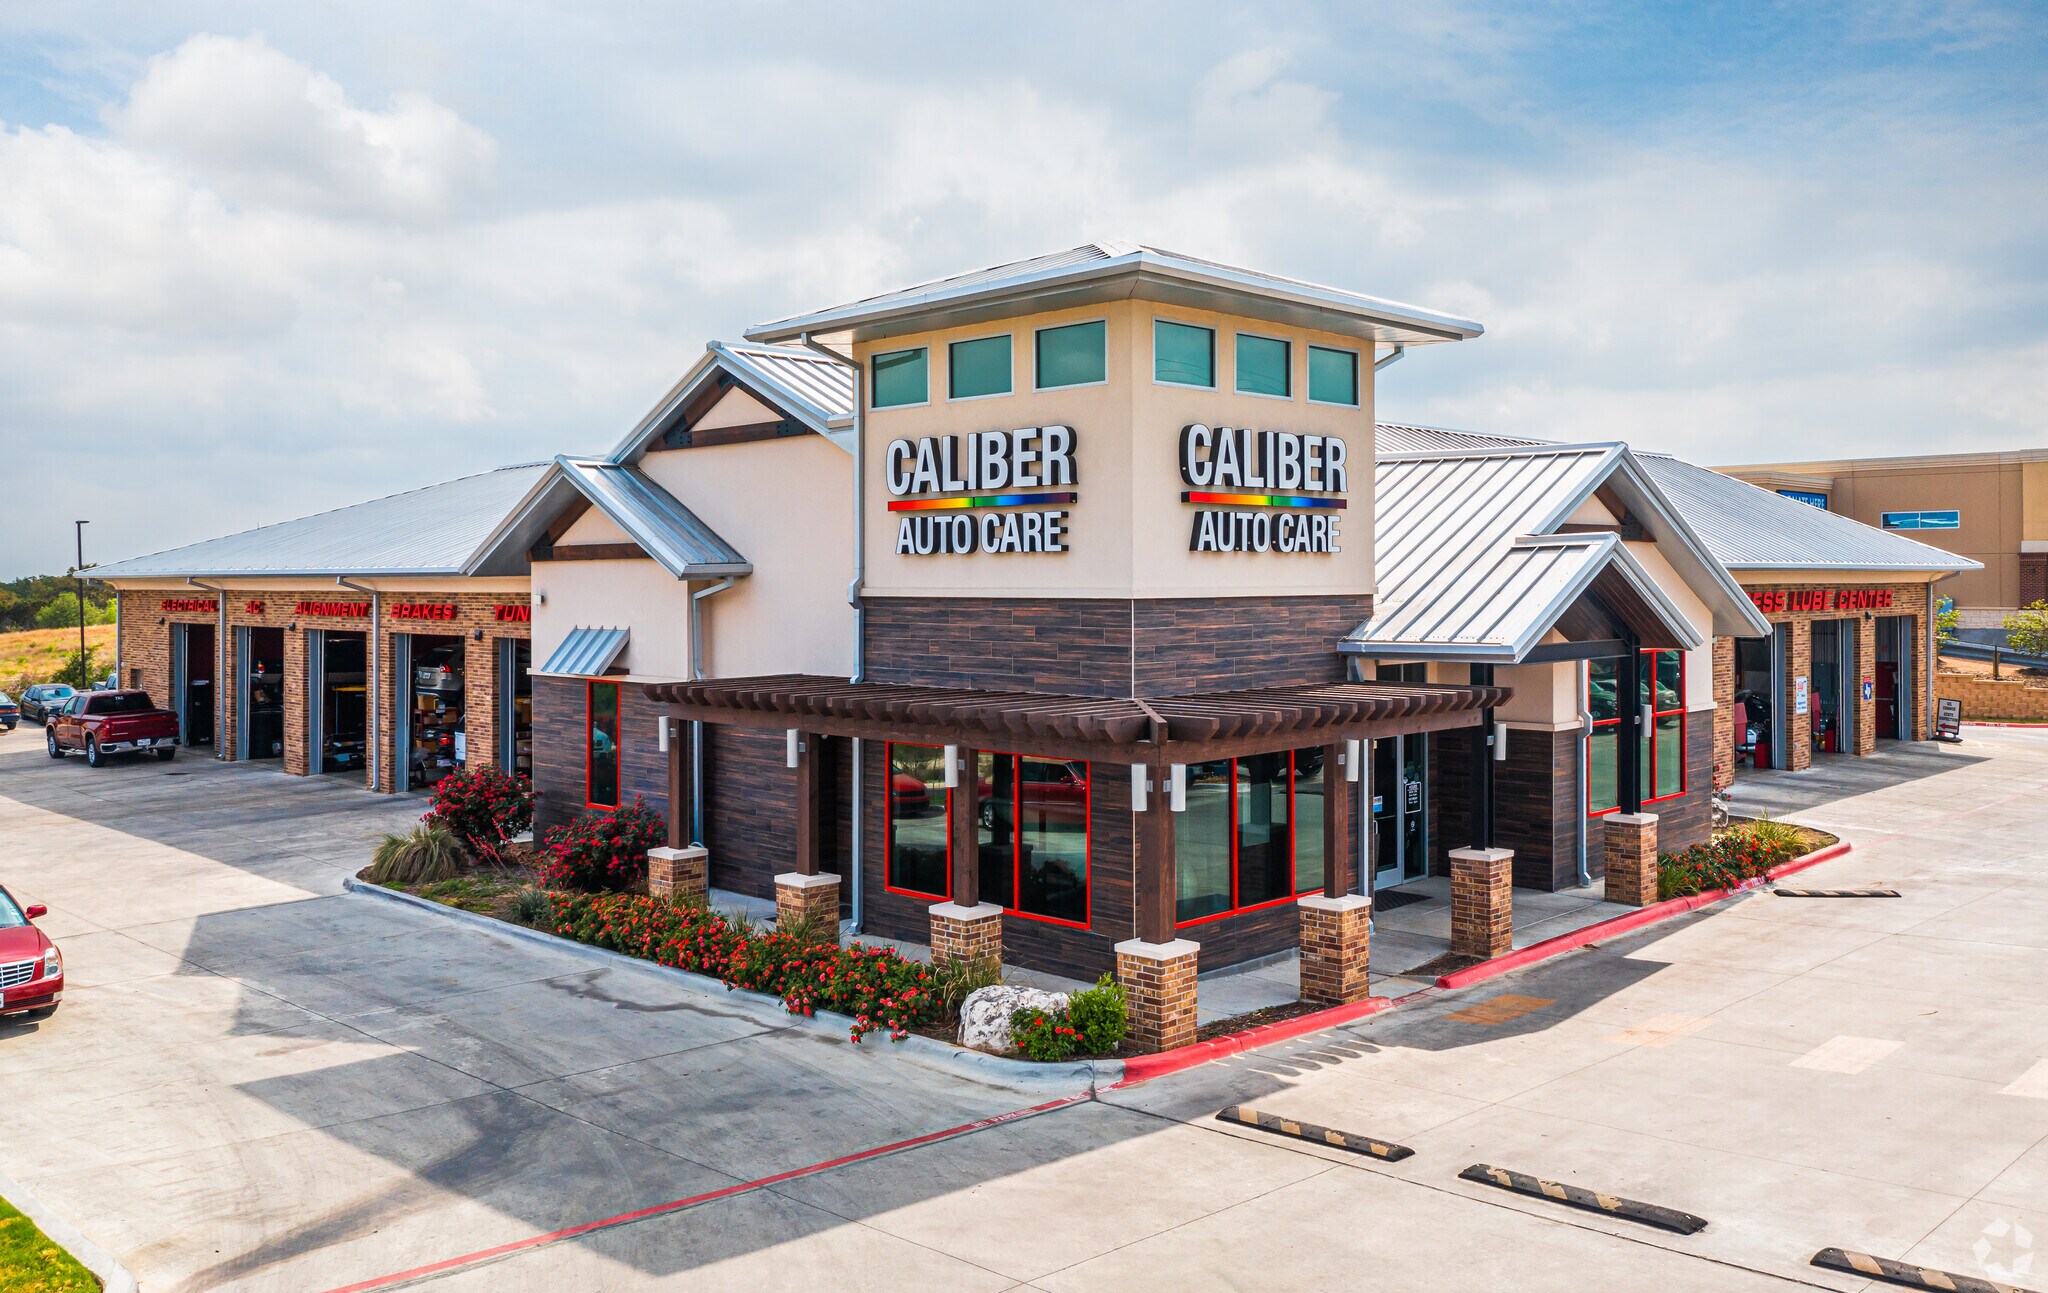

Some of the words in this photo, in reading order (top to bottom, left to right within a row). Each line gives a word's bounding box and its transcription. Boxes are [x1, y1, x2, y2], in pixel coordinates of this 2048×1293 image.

[886, 425, 1078, 496] CALIBER
[1179, 424, 1348, 492] CALIBER
[895, 514, 978, 555] AUTO
[981, 511, 1069, 554] CARE
[1189, 511, 1270, 552] AUTO
[1271, 513, 1342, 553] CARE
[161, 600, 218, 612] ELECTRICAL
[245, 601, 264, 614] AC
[294, 602, 369, 617] ALIGNMENT
[1747, 591, 1785, 613] ESS
[1790, 590, 1833, 611] LUBE
[1838, 589, 1894, 610] CENTER
[390, 603, 457, 620] BRAKES
[990, 1108, 1037, 1124] PARKING
